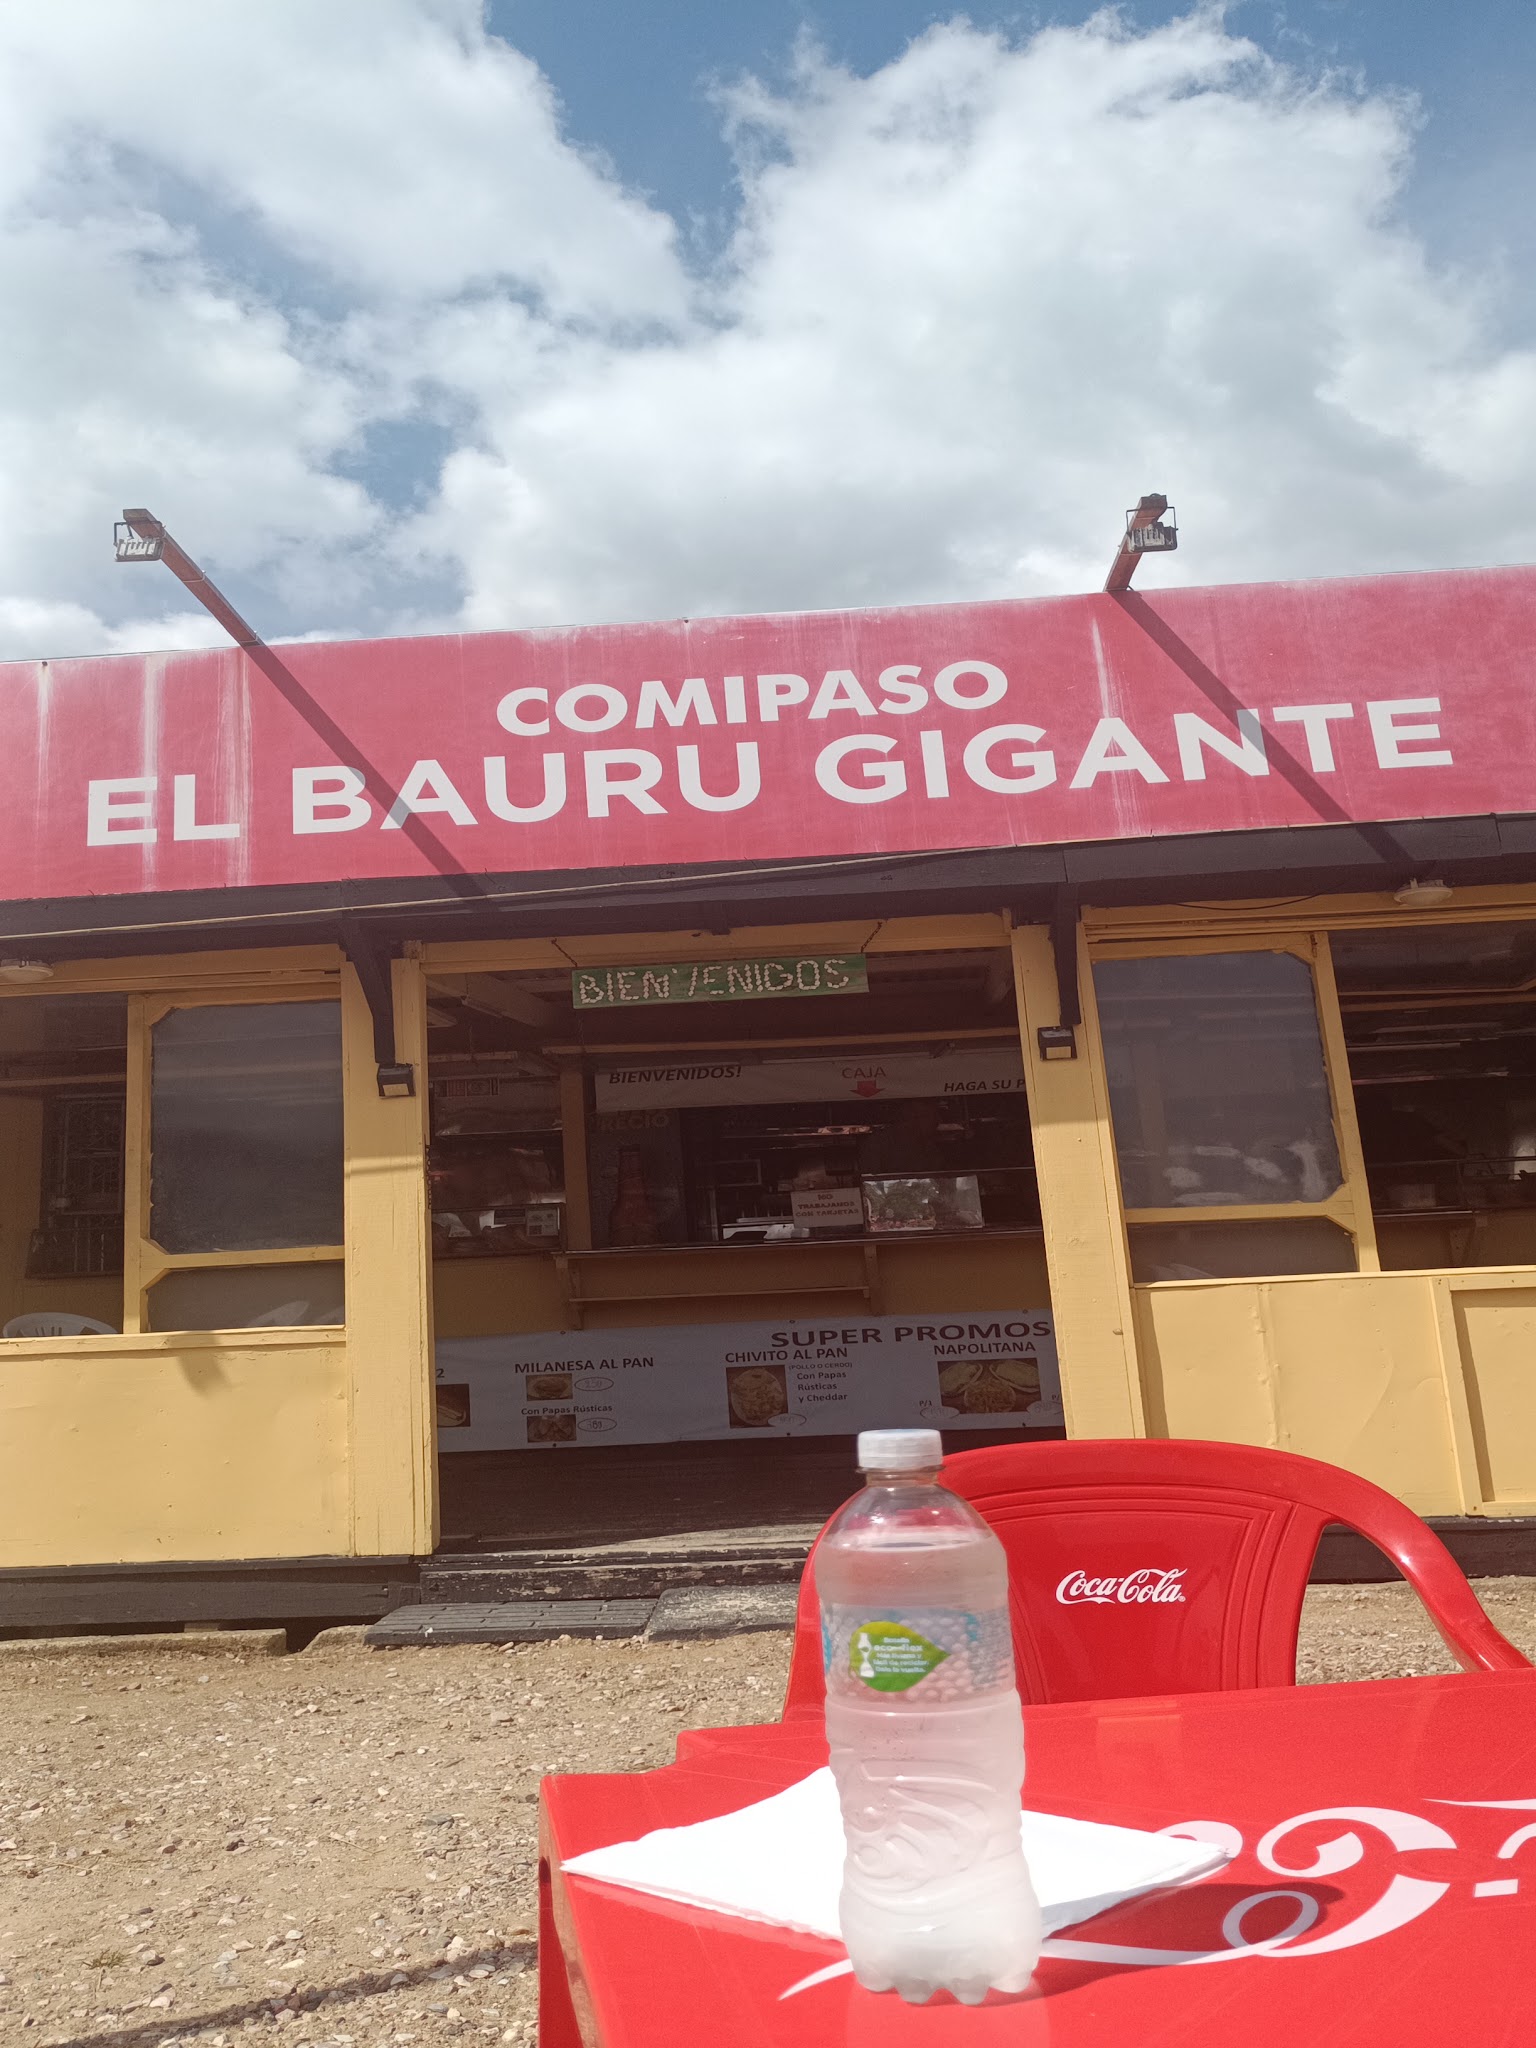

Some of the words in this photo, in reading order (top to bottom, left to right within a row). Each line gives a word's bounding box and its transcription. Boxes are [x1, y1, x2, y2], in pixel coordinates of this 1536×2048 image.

[496, 660, 1009, 736] COMIPASO
[86, 774, 241, 847] EL
[292, 741, 762, 835] BAURU
[814, 697, 1453, 804] GIGANTE
[609, 1066, 742, 1084] BIENVENIDOS!
[841, 1066, 887, 1080] CAJA
[943, 1081, 988, 1093] HAGA
[991, 1079, 1012, 1090] SU
[817, 1193, 834, 1201] NO
[797, 1201, 855, 1210] TRABAJAMOS
[816, 1208, 859, 1217] TARJETAS
[770, 1327, 883, 1348] SUPER
[894, 1321, 1051, 1342] PROMOS
[725, 1350, 788, 1363] CHIVITO
[793, 1349, 812, 1360] AL
[816, 1347, 848, 1359] PAN
[933, 1341, 1036, 1355] NAPOLITANA
[514, 1360, 595, 1374] MILANESA
[599, 1359, 619, 1370] AL
[622, 1357, 655, 1369] PAN
[796, 1372, 816, 1380] Con
[818, 1371, 847, 1380] Papas
[797, 1382, 838, 1391] Rústicas
[798, 1396, 805, 1404] y
[806, 1393, 848, 1402] Cheddar
[521, 1407, 540, 1416] Con
[542, 1405, 571, 1415] Papas
[573, 1404, 613, 1413] Rústicas
[1056, 1568, 1188, 1605] Coca-Cola
